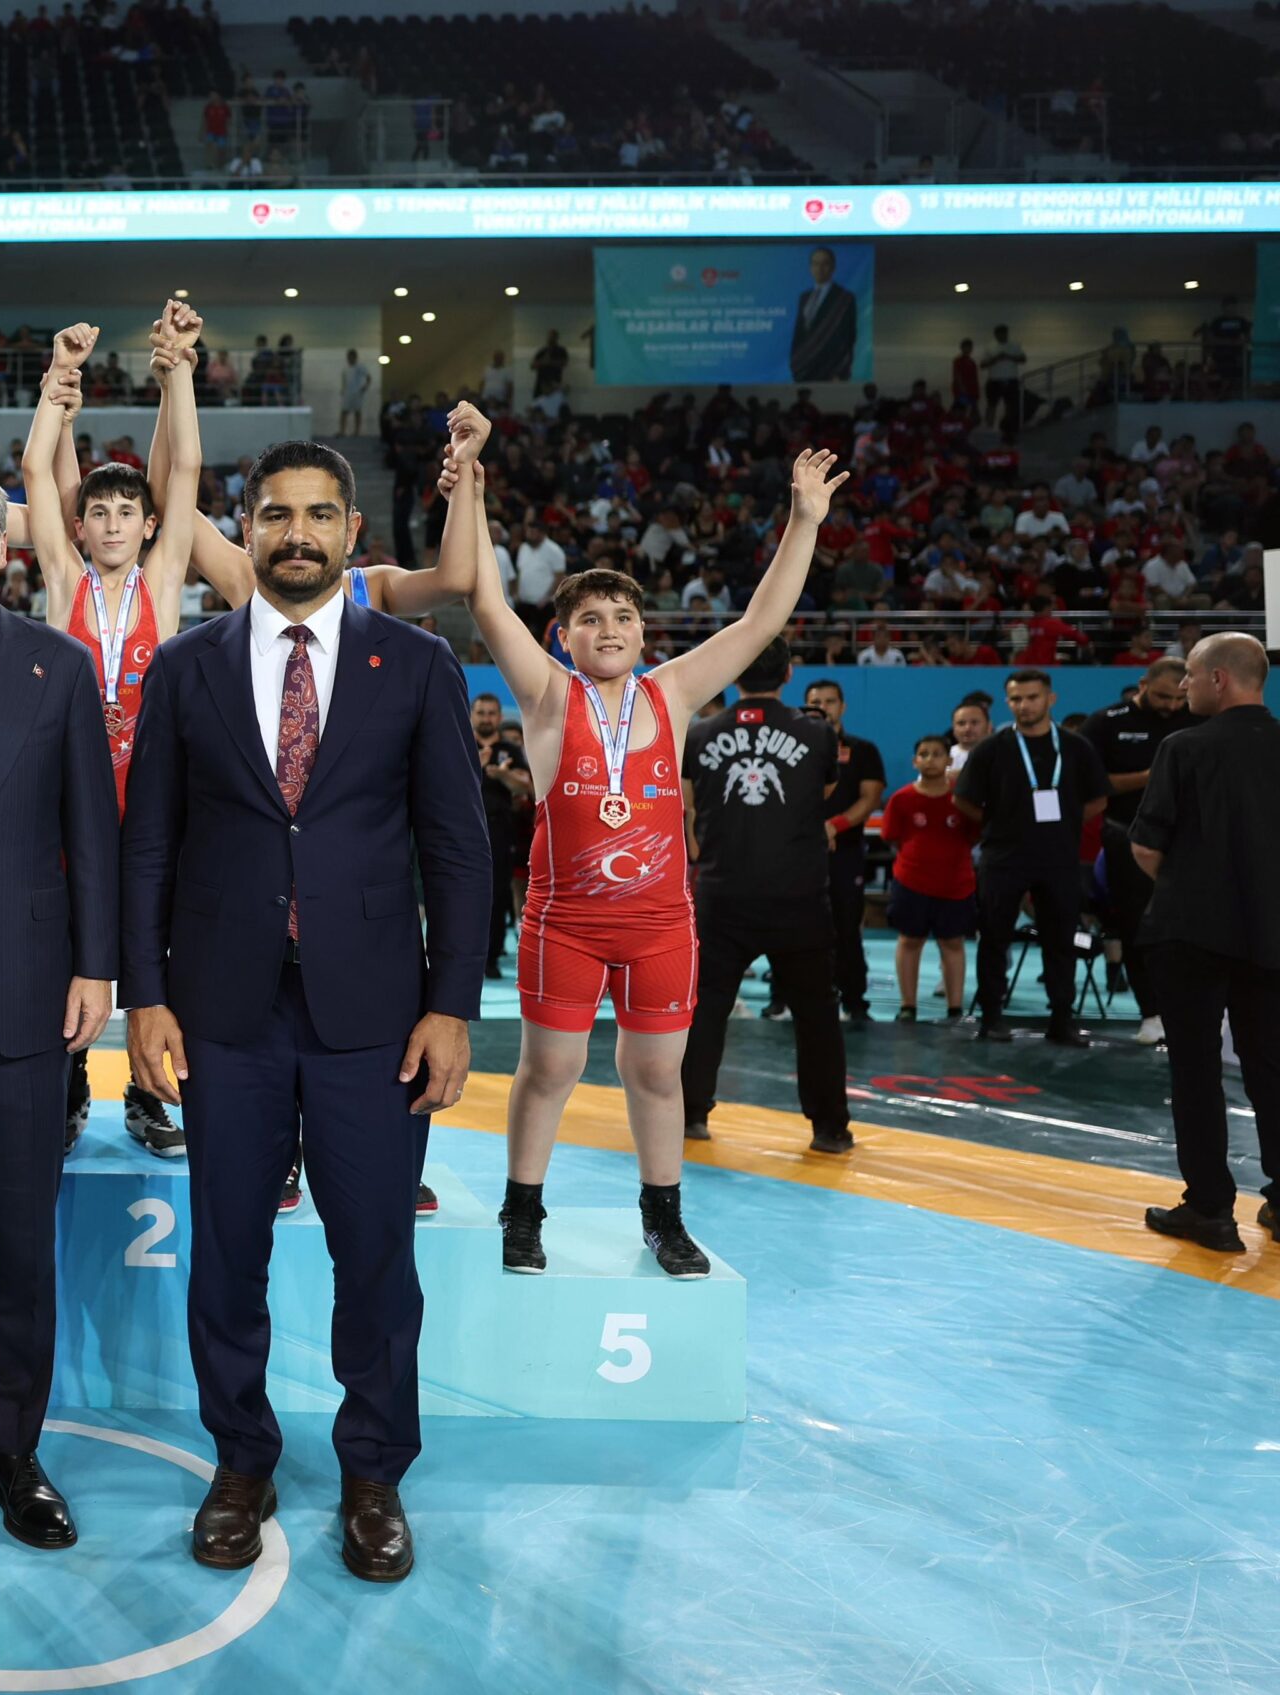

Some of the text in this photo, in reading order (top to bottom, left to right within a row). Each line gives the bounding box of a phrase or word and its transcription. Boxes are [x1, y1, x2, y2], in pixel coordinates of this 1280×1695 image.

[919, 193, 940, 208] 15
[943, 193, 1016, 208] TEMMUZ
[1018, 191, 1123, 207] DEMOKRASİ
[1126, 191, 1149, 206] VE
[1152, 190, 1200, 206] MİLLİ
[1203, 189, 1261, 206] BİRLİK
[1021, 208, 1245, 225] TÜRKİYE ŞAMPİYONALARI
[698, 725, 809, 771] SPOR ŞUBE
[124, 1197, 177, 1268] 2
[596, 1313, 652, 1384] 5
